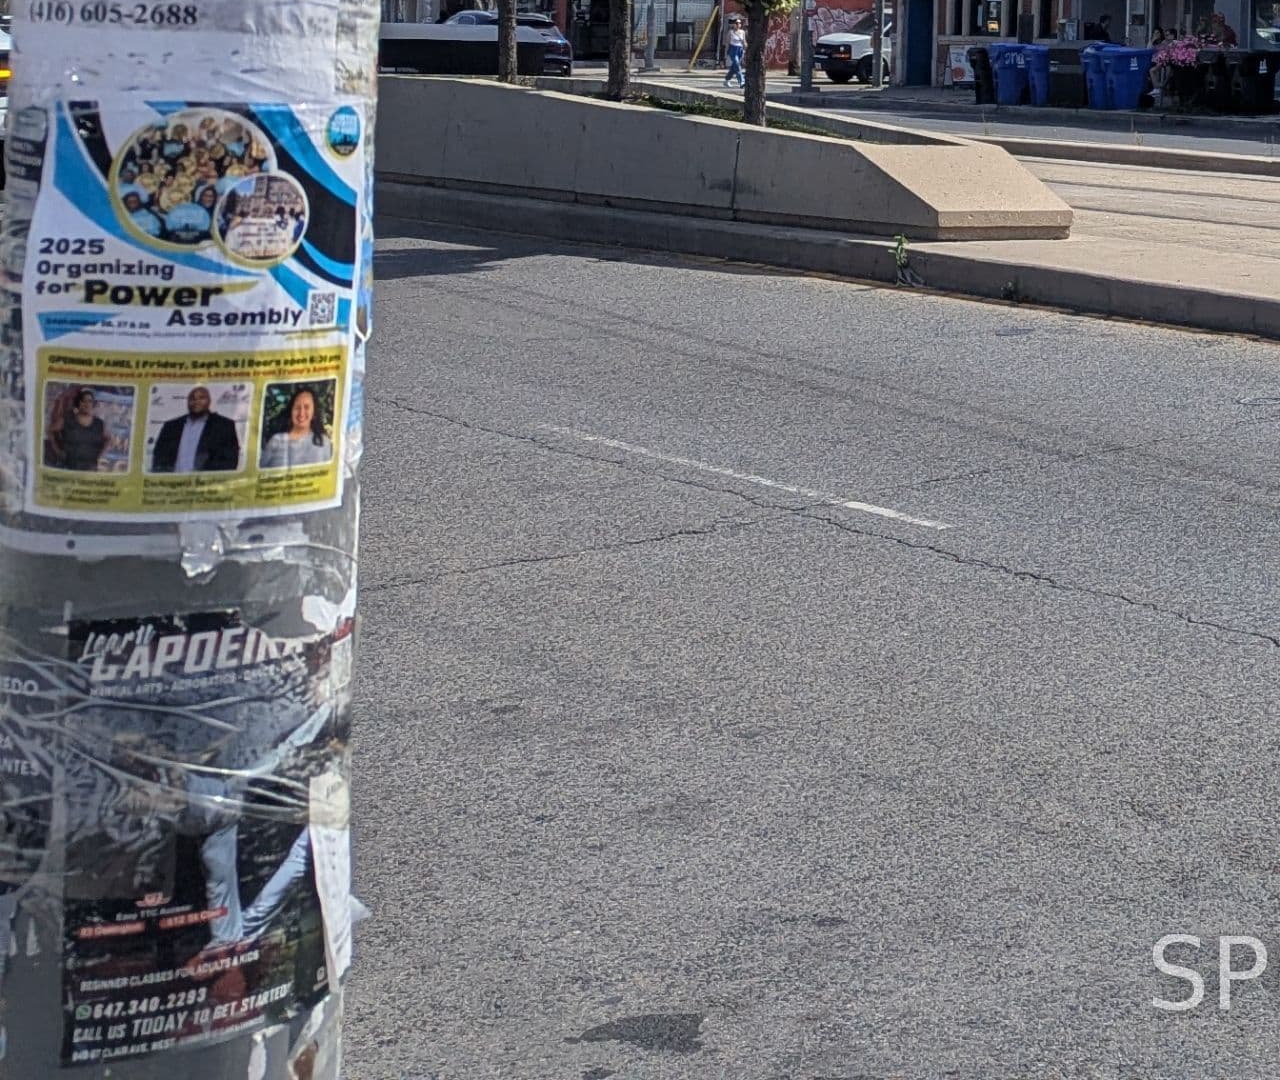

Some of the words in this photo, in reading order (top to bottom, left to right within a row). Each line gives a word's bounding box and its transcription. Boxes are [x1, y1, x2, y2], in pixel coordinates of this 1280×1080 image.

[30, 0, 74, 25] (416)
[80, 3, 199, 26] 605-2688
[39, 238, 105, 255] 2025
[37, 258, 175, 280] Organizing
[35, 280, 77, 295] for
[84, 280, 223, 307] Power
[166, 308, 302, 330] Assembly
[96, 359, 133, 369] PANEL
[247, 358, 281, 368] Doors
[77, 623, 156, 663] Learn
[129, 970, 174, 985] CLASSES
[196, 957, 231, 975] ADULTS
[239, 950, 260, 965] KIDS
[72, 1027, 103, 1043] CALL
[107, 1025, 125, 1039] US
[131, 1011, 189, 1037] TODAY
[193, 1009, 210, 1025] TO
[212, 1001, 236, 1019] GET
[150, 1037, 176, 1051] WEST
